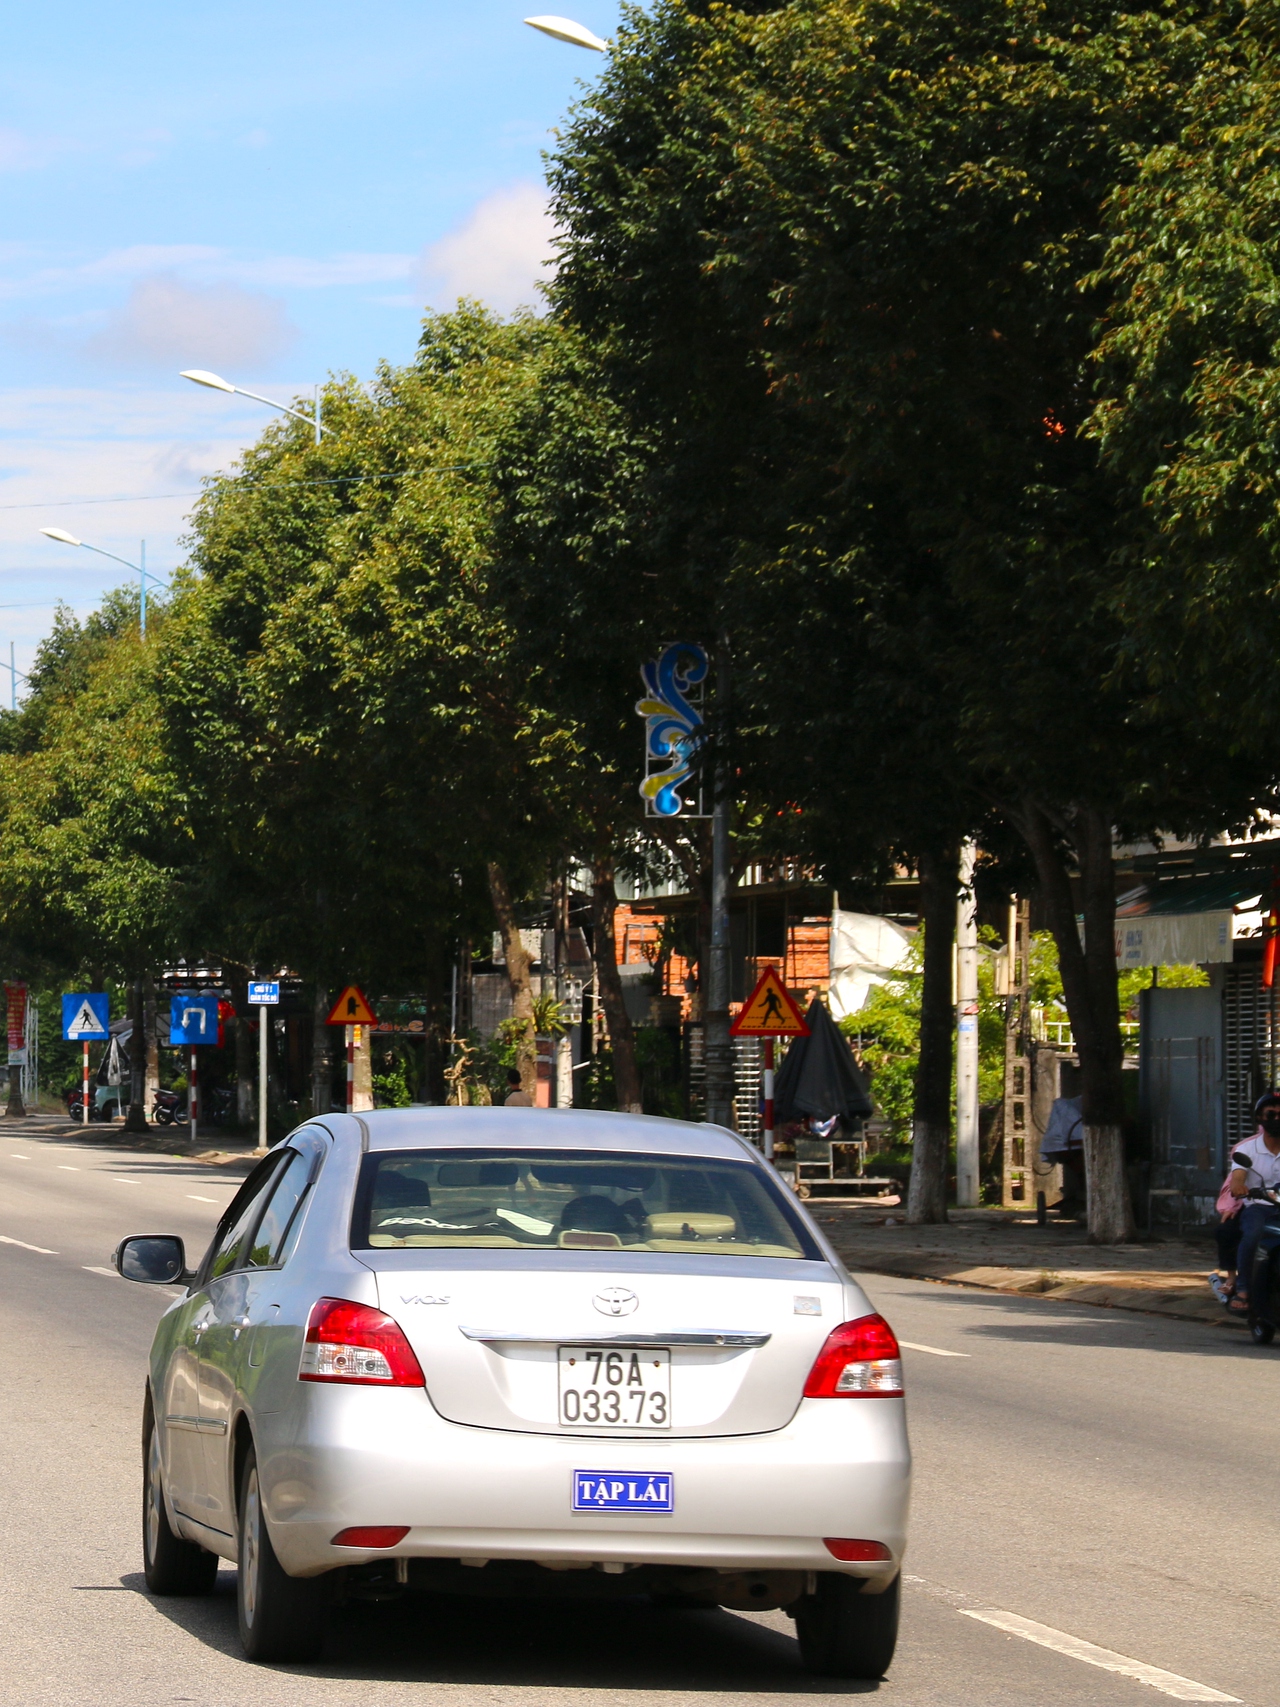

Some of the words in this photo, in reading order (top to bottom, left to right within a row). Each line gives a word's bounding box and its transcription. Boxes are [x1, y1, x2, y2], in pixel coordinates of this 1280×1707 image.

[586, 1352, 643, 1386] 76A
[563, 1389, 667, 1424] 033.73
[579, 1478, 625, 1505] TẬP
[627, 1477, 669, 1502] LÁI
